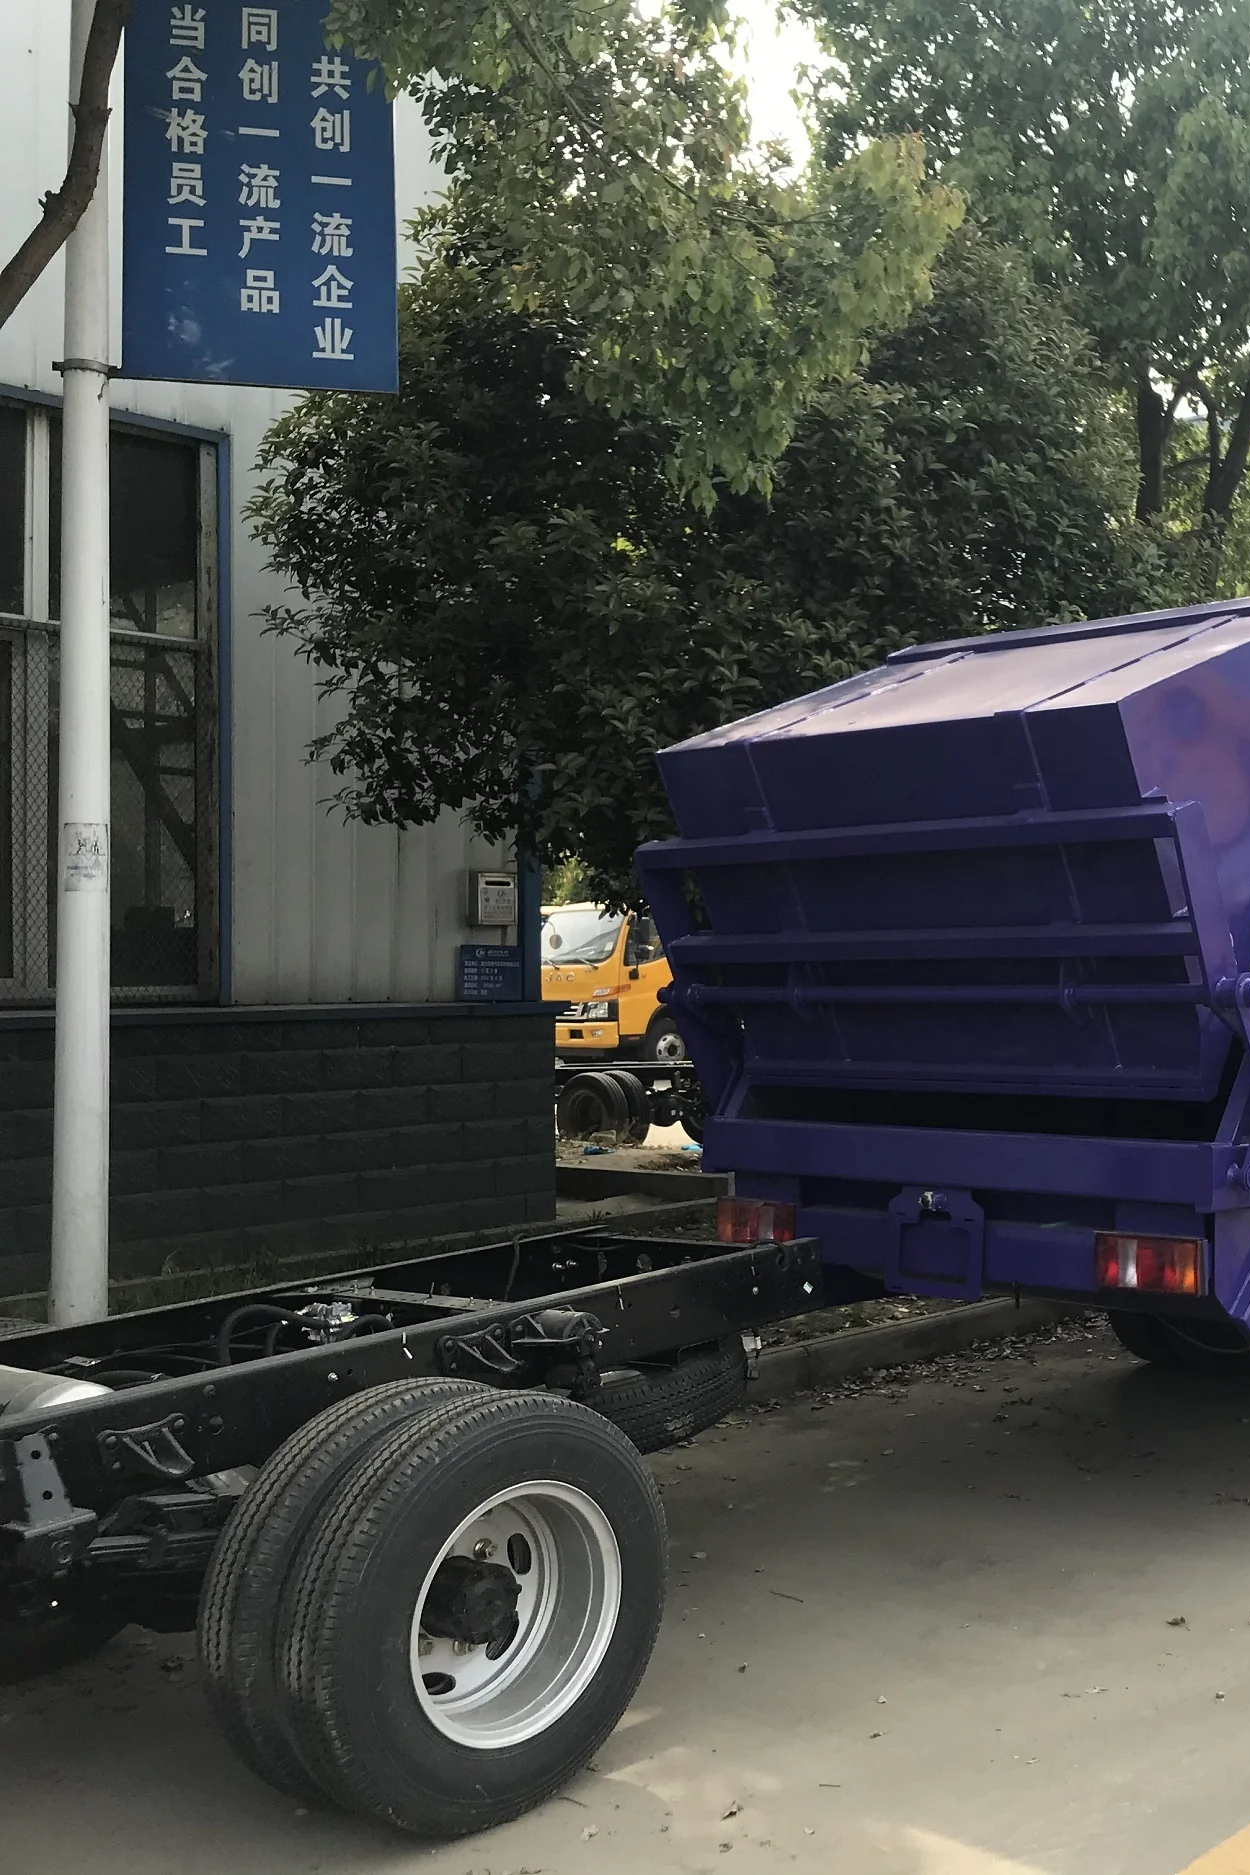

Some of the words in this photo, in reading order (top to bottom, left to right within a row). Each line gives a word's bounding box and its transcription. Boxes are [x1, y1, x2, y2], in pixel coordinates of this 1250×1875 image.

[165, 4, 208, 257] 当合格员工
[238, 6, 281, 314] 同创一流产品
[310, 55, 355, 361] 共创一流企业
[545, 972, 575, 982] JAC
